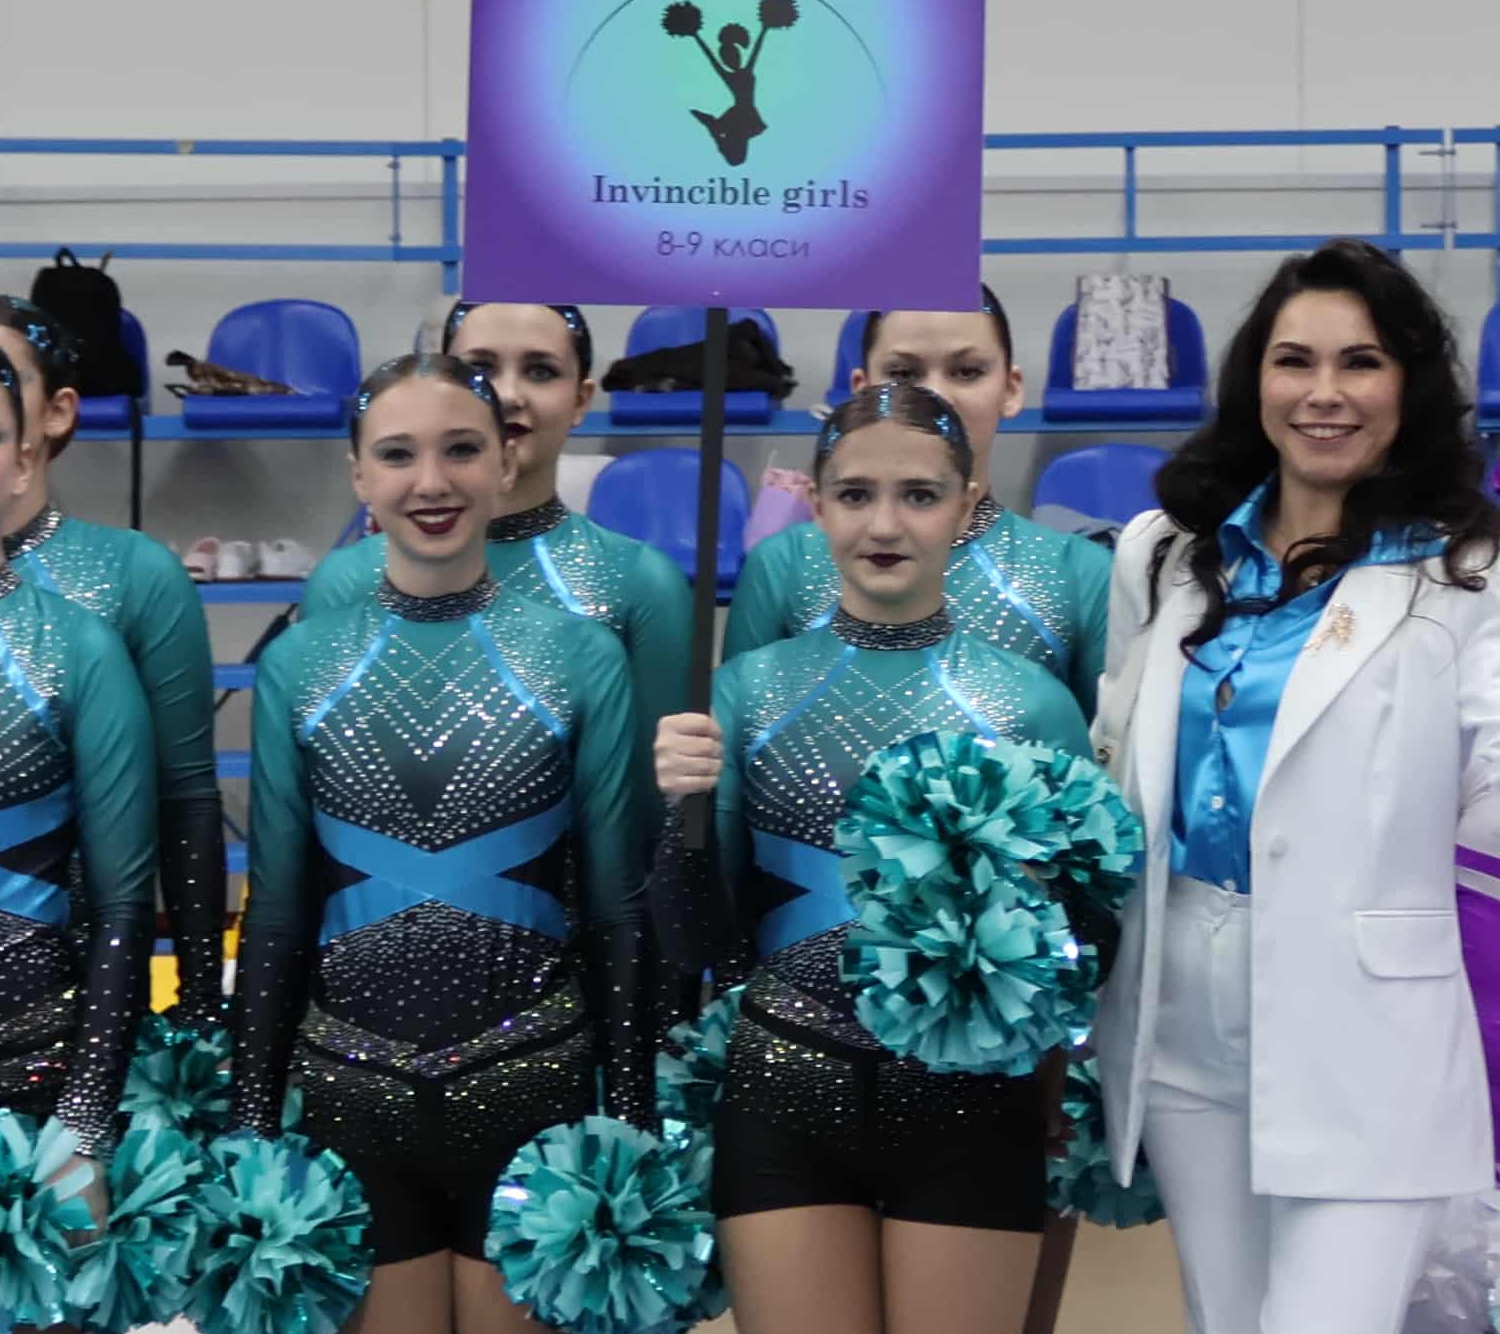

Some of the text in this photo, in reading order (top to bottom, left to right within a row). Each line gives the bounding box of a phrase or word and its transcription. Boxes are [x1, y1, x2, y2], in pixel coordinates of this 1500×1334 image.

[593, 175, 869, 214] Invincible girls
[657, 230, 811, 259] 8-9 класи
